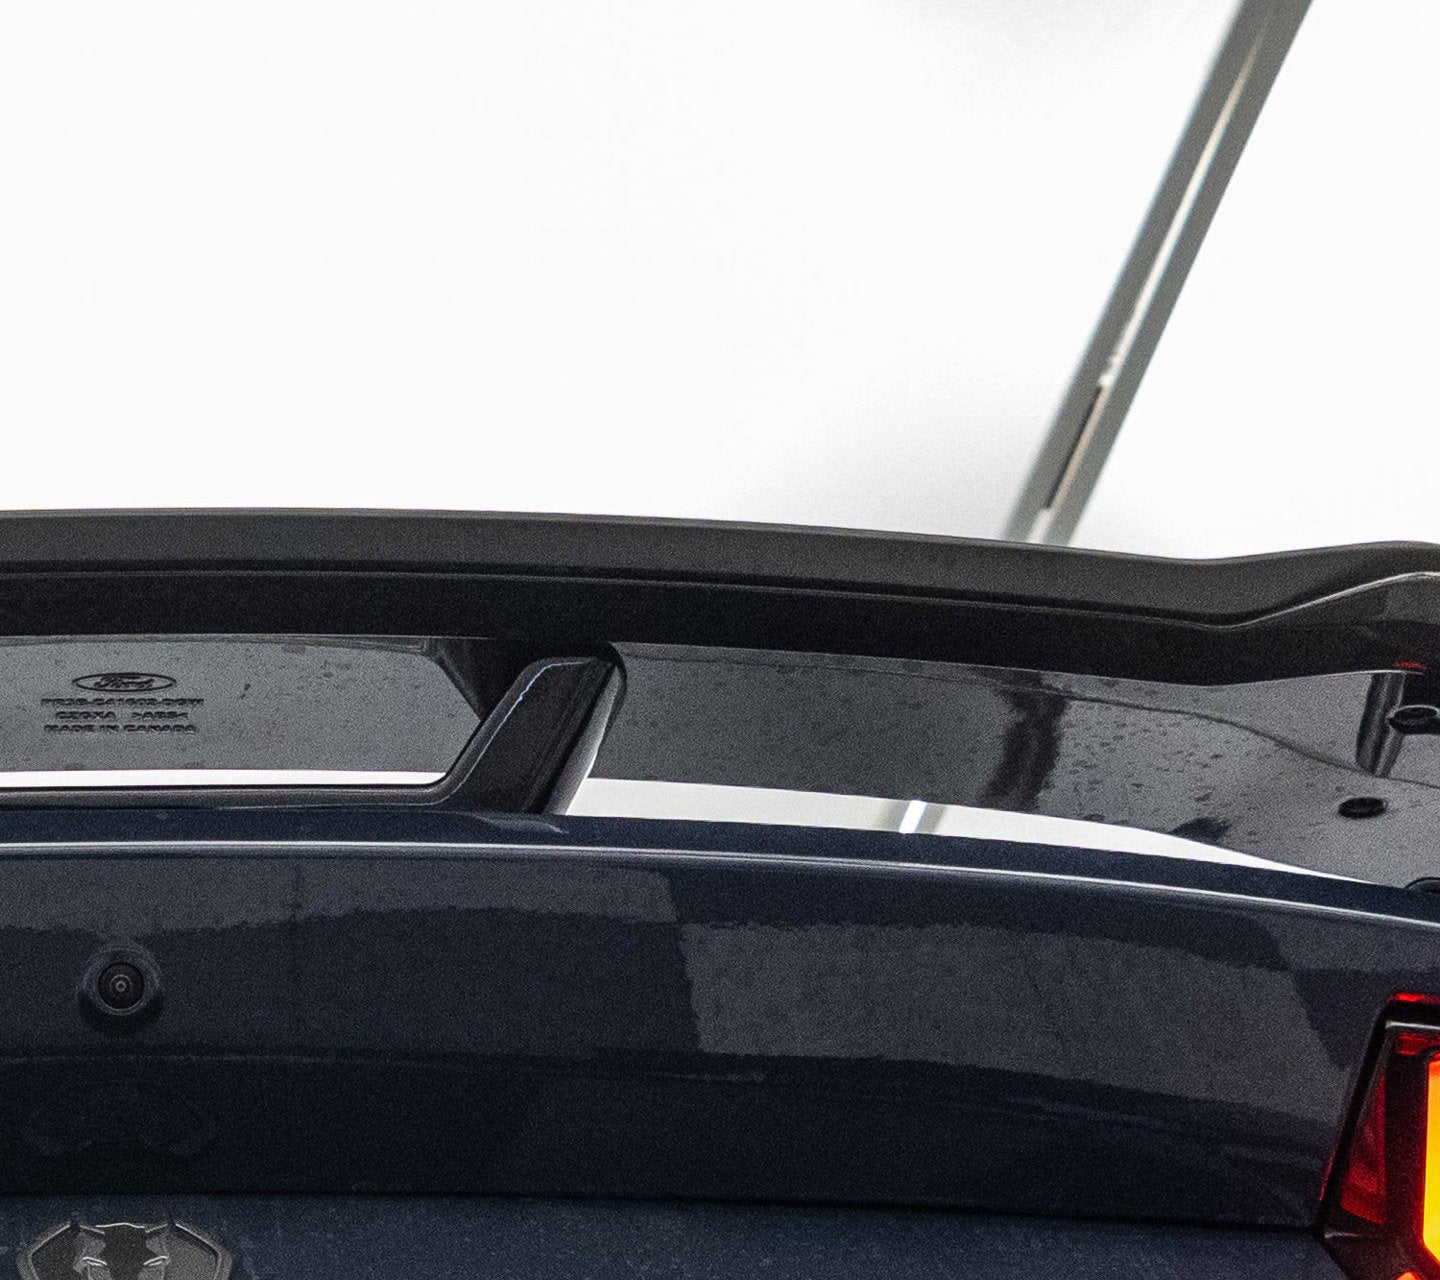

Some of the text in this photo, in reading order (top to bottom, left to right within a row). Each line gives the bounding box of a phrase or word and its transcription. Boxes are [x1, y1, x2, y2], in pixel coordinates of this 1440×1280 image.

[44, 724, 197, 733] MADE IN CANADA
